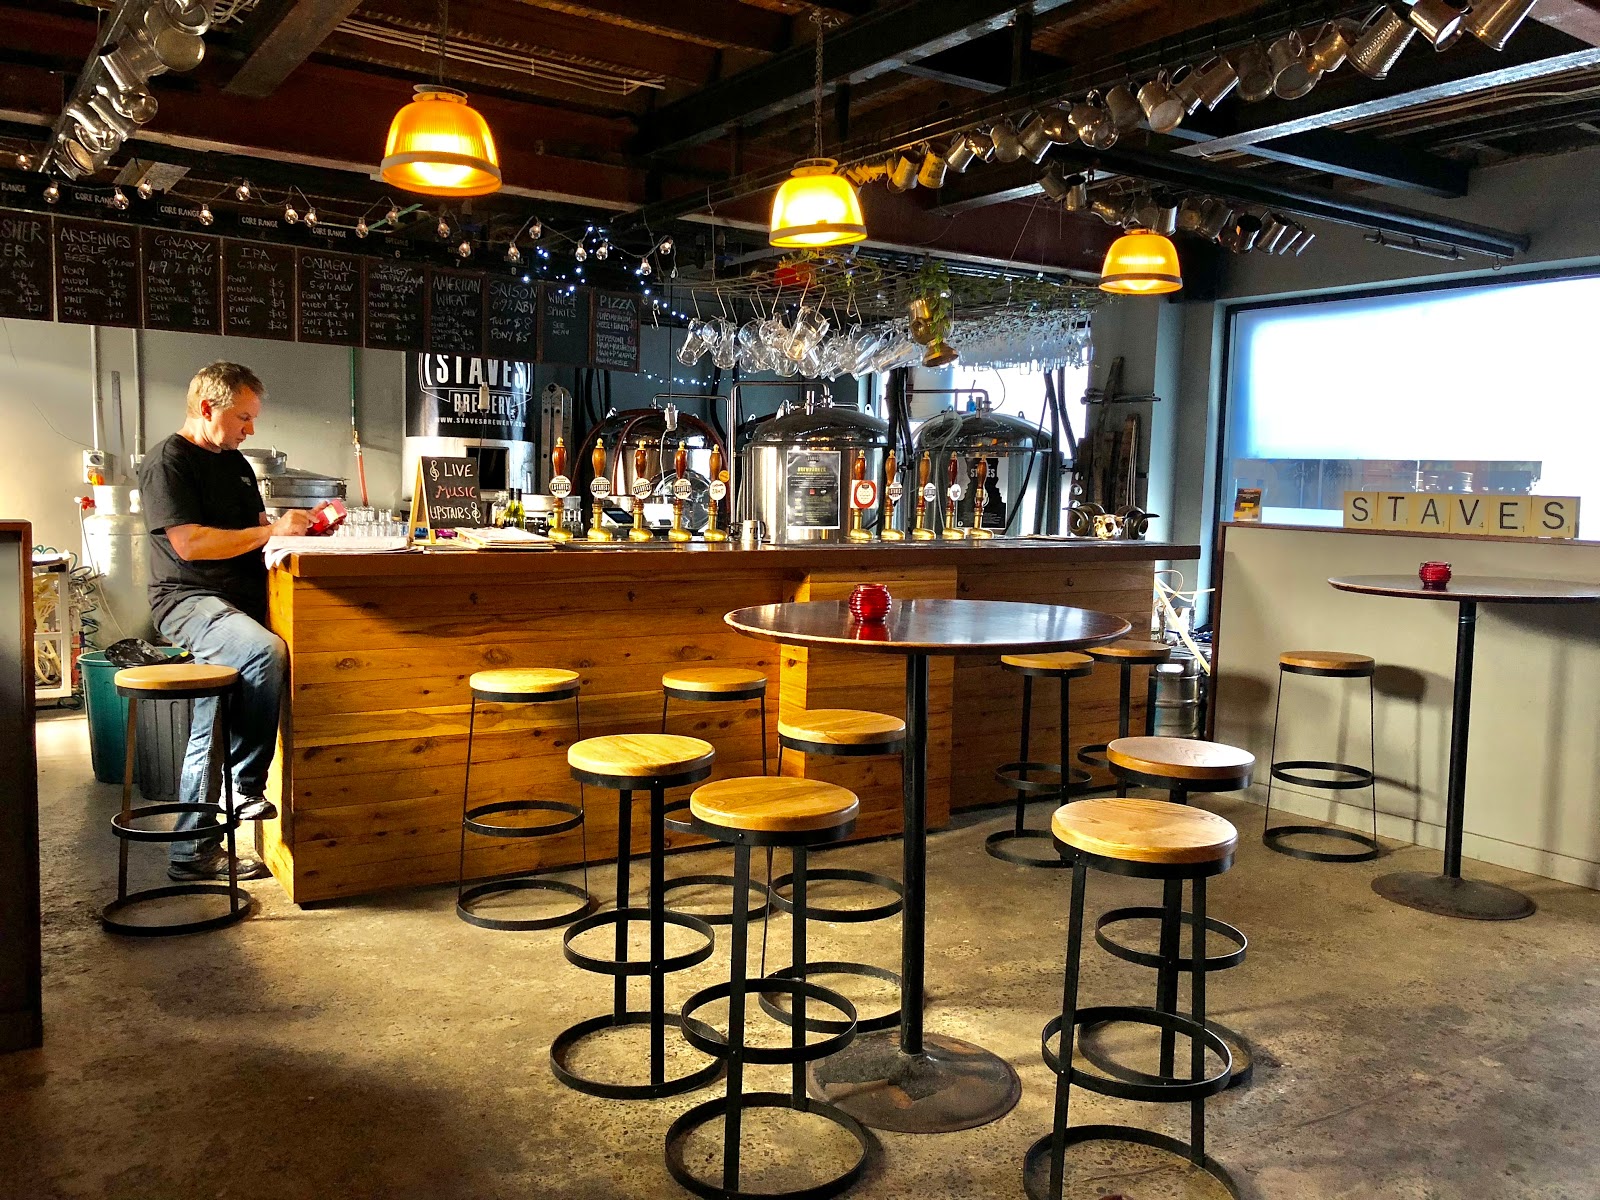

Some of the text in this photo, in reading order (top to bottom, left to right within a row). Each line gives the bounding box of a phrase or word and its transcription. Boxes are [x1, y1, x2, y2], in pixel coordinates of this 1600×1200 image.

[1, 182, 27, 193] RANGE
[75, 192, 114, 206] CORE RANG
[160, 205, 177, 214] CORE
[241, 216, 278, 228] CORE RANGE
[60, 227, 131, 249] ARDENNES
[312, 227, 347, 238] CORE RANGE
[66, 243, 108, 255] TABLE
[154, 235, 211, 254] GALAXY
[64, 252, 96, 264] BEER
[161, 247, 190, 260] PALE
[241, 247, 271, 261] IPA
[395, 249, 401, 258] 6
[302, 255, 359, 273] OATMEAL
[455, 259, 461, 267] 7
[63, 265, 86, 276] PONY
[314, 270, 350, 282] STOUT
[62, 278, 89, 286] MIDDY
[227, 275, 248, 283] PONY
[433, 275, 481, 294] AMERICAN
[227, 285, 253, 293] MIDDY
[334, 283, 354, 292] ABV
[489, 280, 539, 299] SAISON
[302, 291, 322, 300] PONY
[436, 292, 471, 306] WHEAT
[229, 305, 250, 313] PINT
[302, 301, 349, 310] MIDDY $7
[369, 301, 390, 309] MIDDY
[514, 301, 537, 314] ABV
[600, 294, 637, 313] PIZZA
[302, 310, 339, 318] SCHOONER
[546, 306, 577, 318] SPIRITS
[230, 317, 251, 326] JUG
[489, 316, 512, 325] TULIP
[552, 321, 565, 329] SEE
[303, 327, 323, 336] JUG
[491, 328, 532, 344] PONY $5
[454, 393, 511, 415] BREERY
[444, 462, 474, 478] LIVE
[970, 468, 996, 478] STES
[435, 485, 478, 499] MUSIC
[429, 504, 472, 520] UPSTAIRS
[1351, 496, 1565, 530] STAVES
